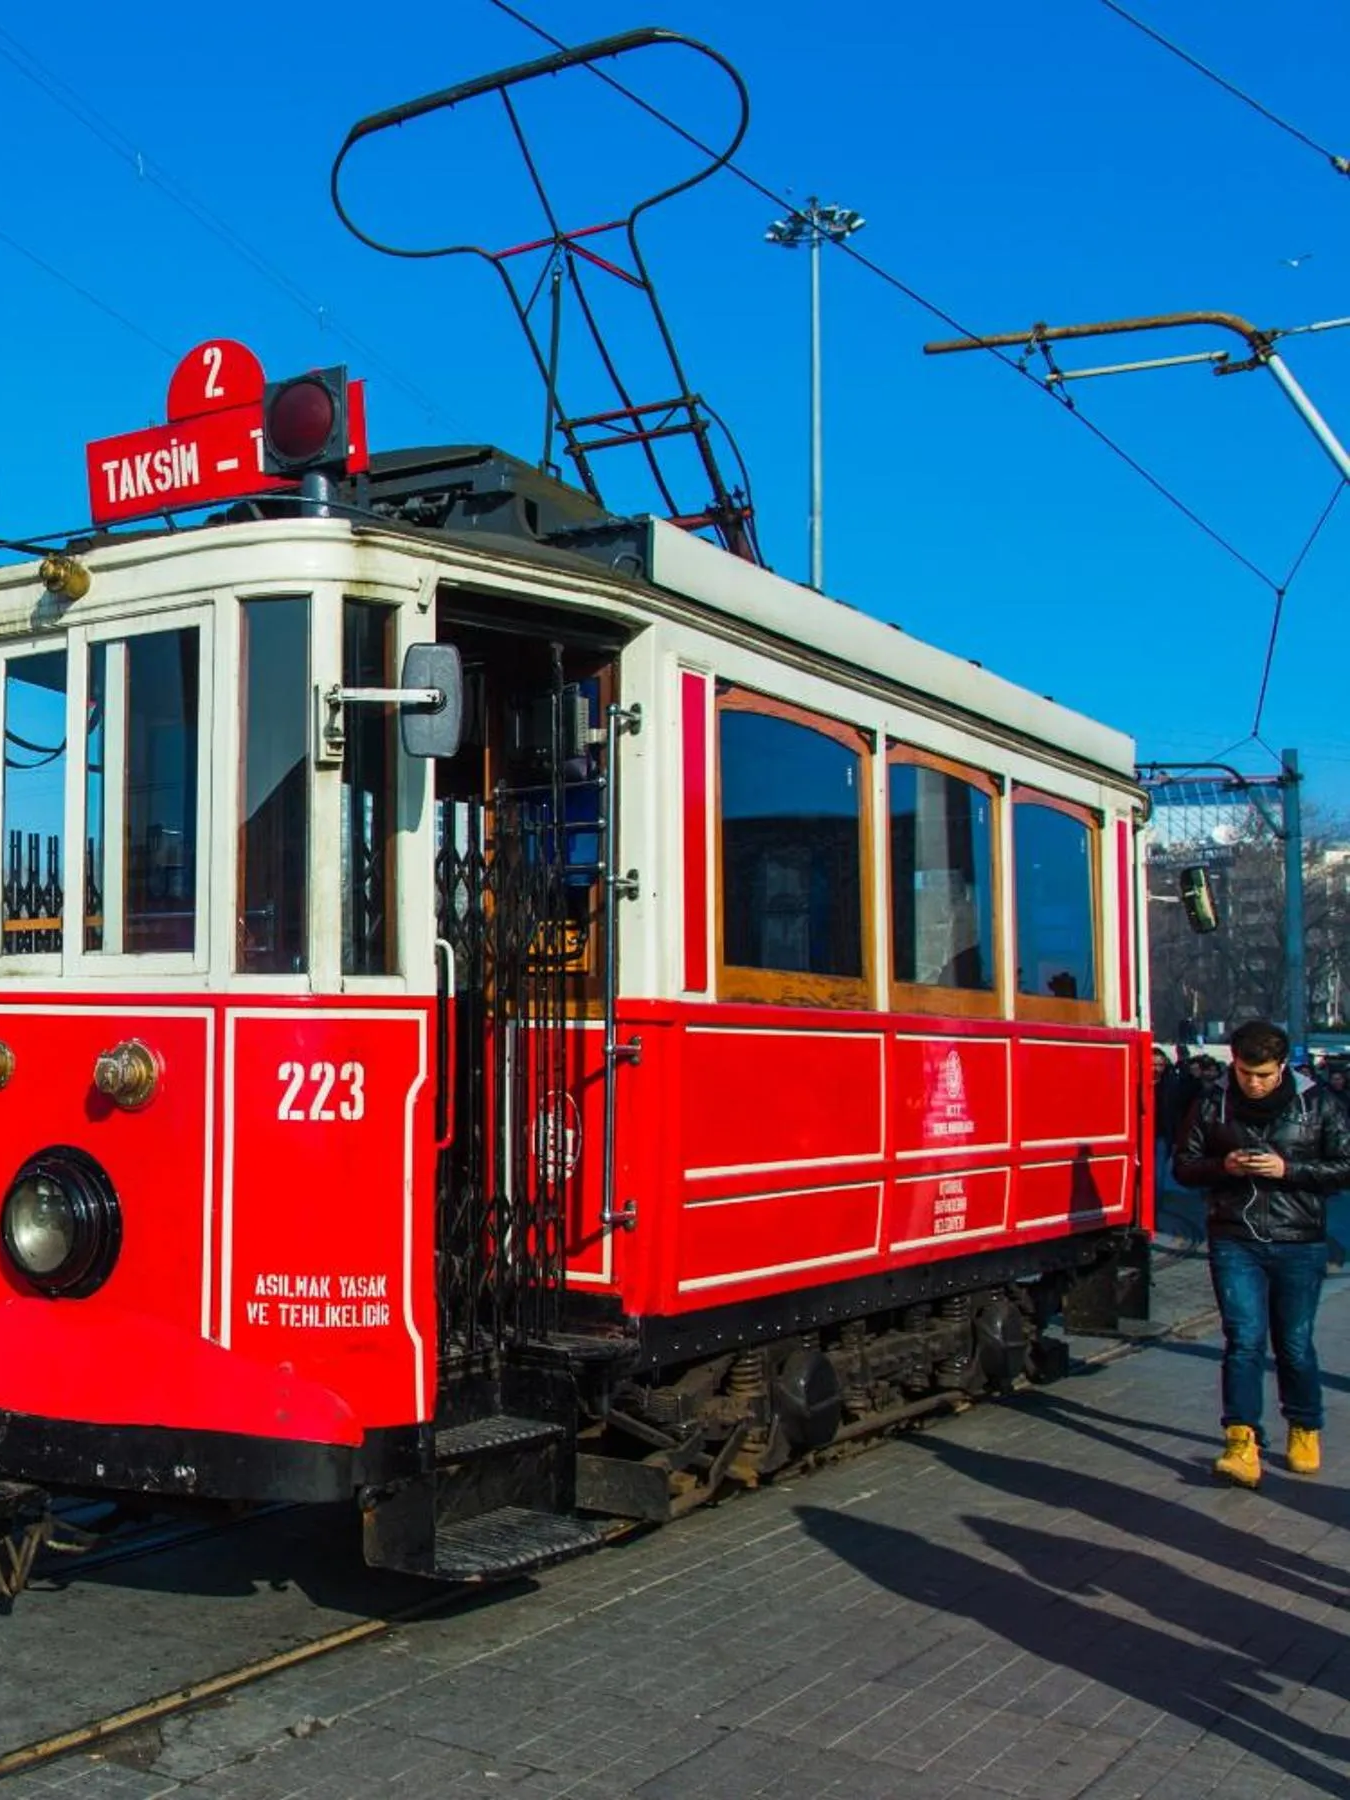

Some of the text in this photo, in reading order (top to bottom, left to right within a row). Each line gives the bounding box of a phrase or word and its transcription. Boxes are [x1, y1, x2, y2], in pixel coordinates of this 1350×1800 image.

[202, 346, 225, 399] 2
[101, 438, 200, 504] TAKSİM
[277, 1061, 365, 1121] 223
[255, 1273, 387, 1299] ASILMAK YASAK
[246, 1301, 390, 1328] VE TEHLİKELİDİR
